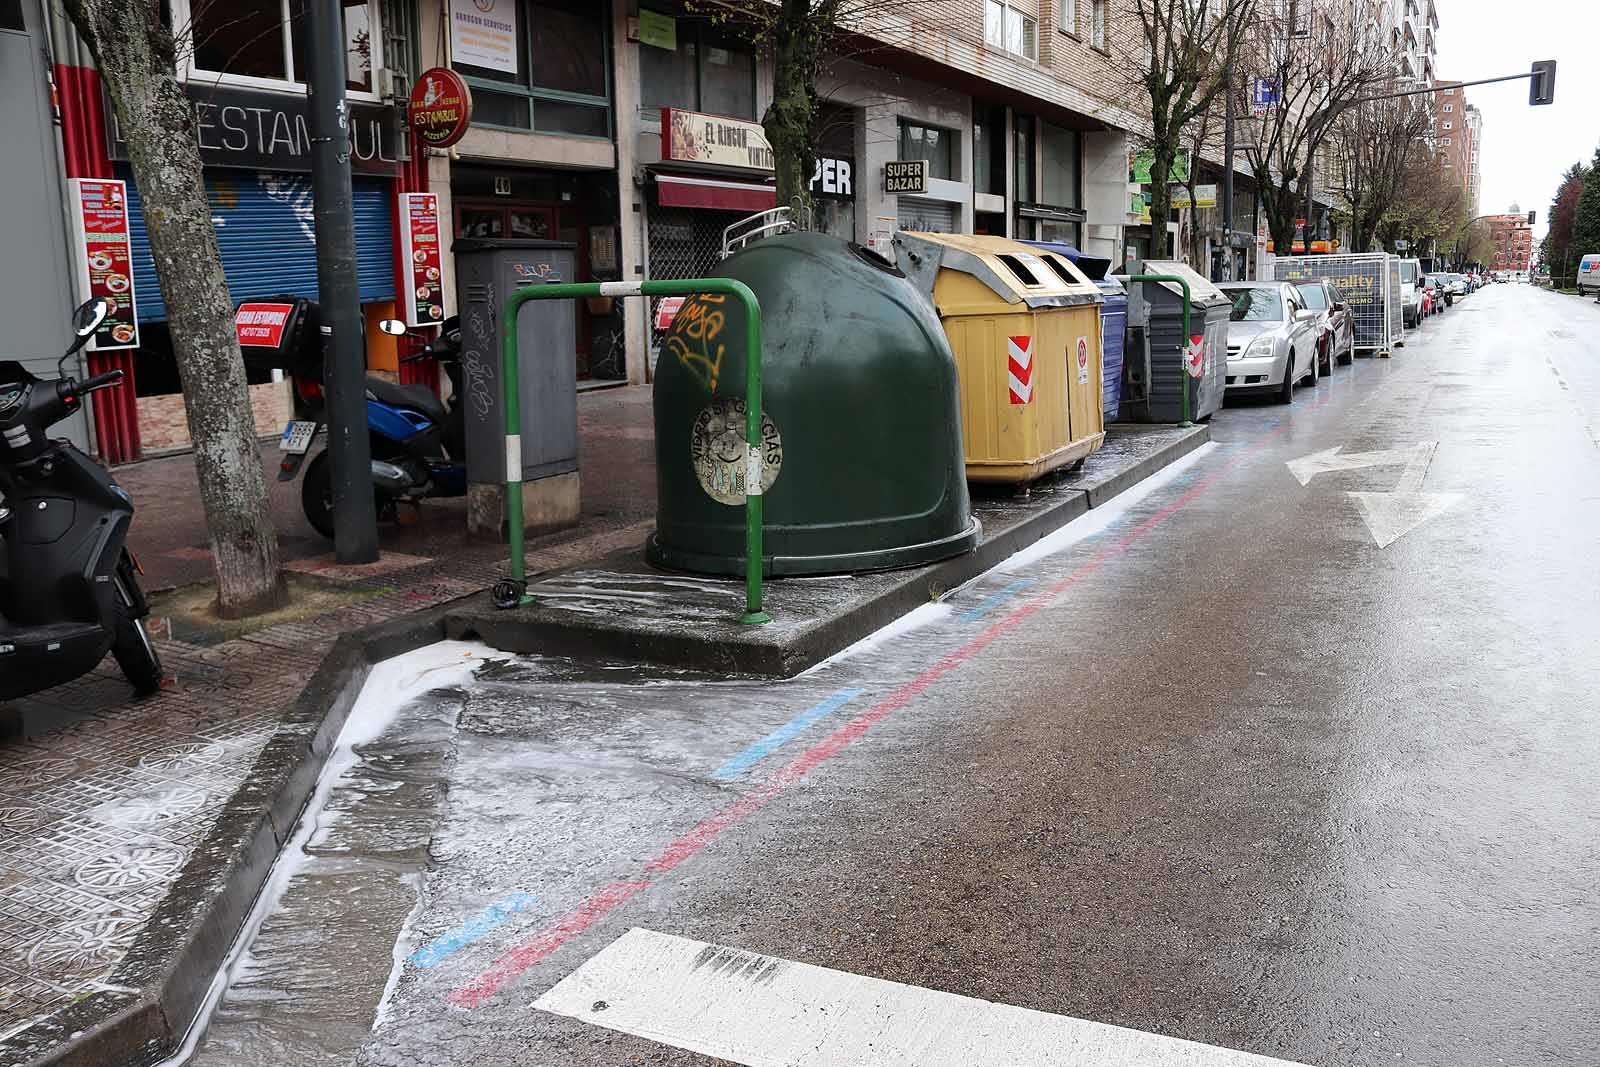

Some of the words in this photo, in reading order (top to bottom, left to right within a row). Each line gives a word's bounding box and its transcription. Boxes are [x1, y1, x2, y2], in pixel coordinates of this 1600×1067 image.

[414, 109, 459, 127] ESTAMBUL
[705, 122, 716, 144] EL
[887, 163, 922, 177] SUPER
[887, 177, 922, 191] BAZAR
